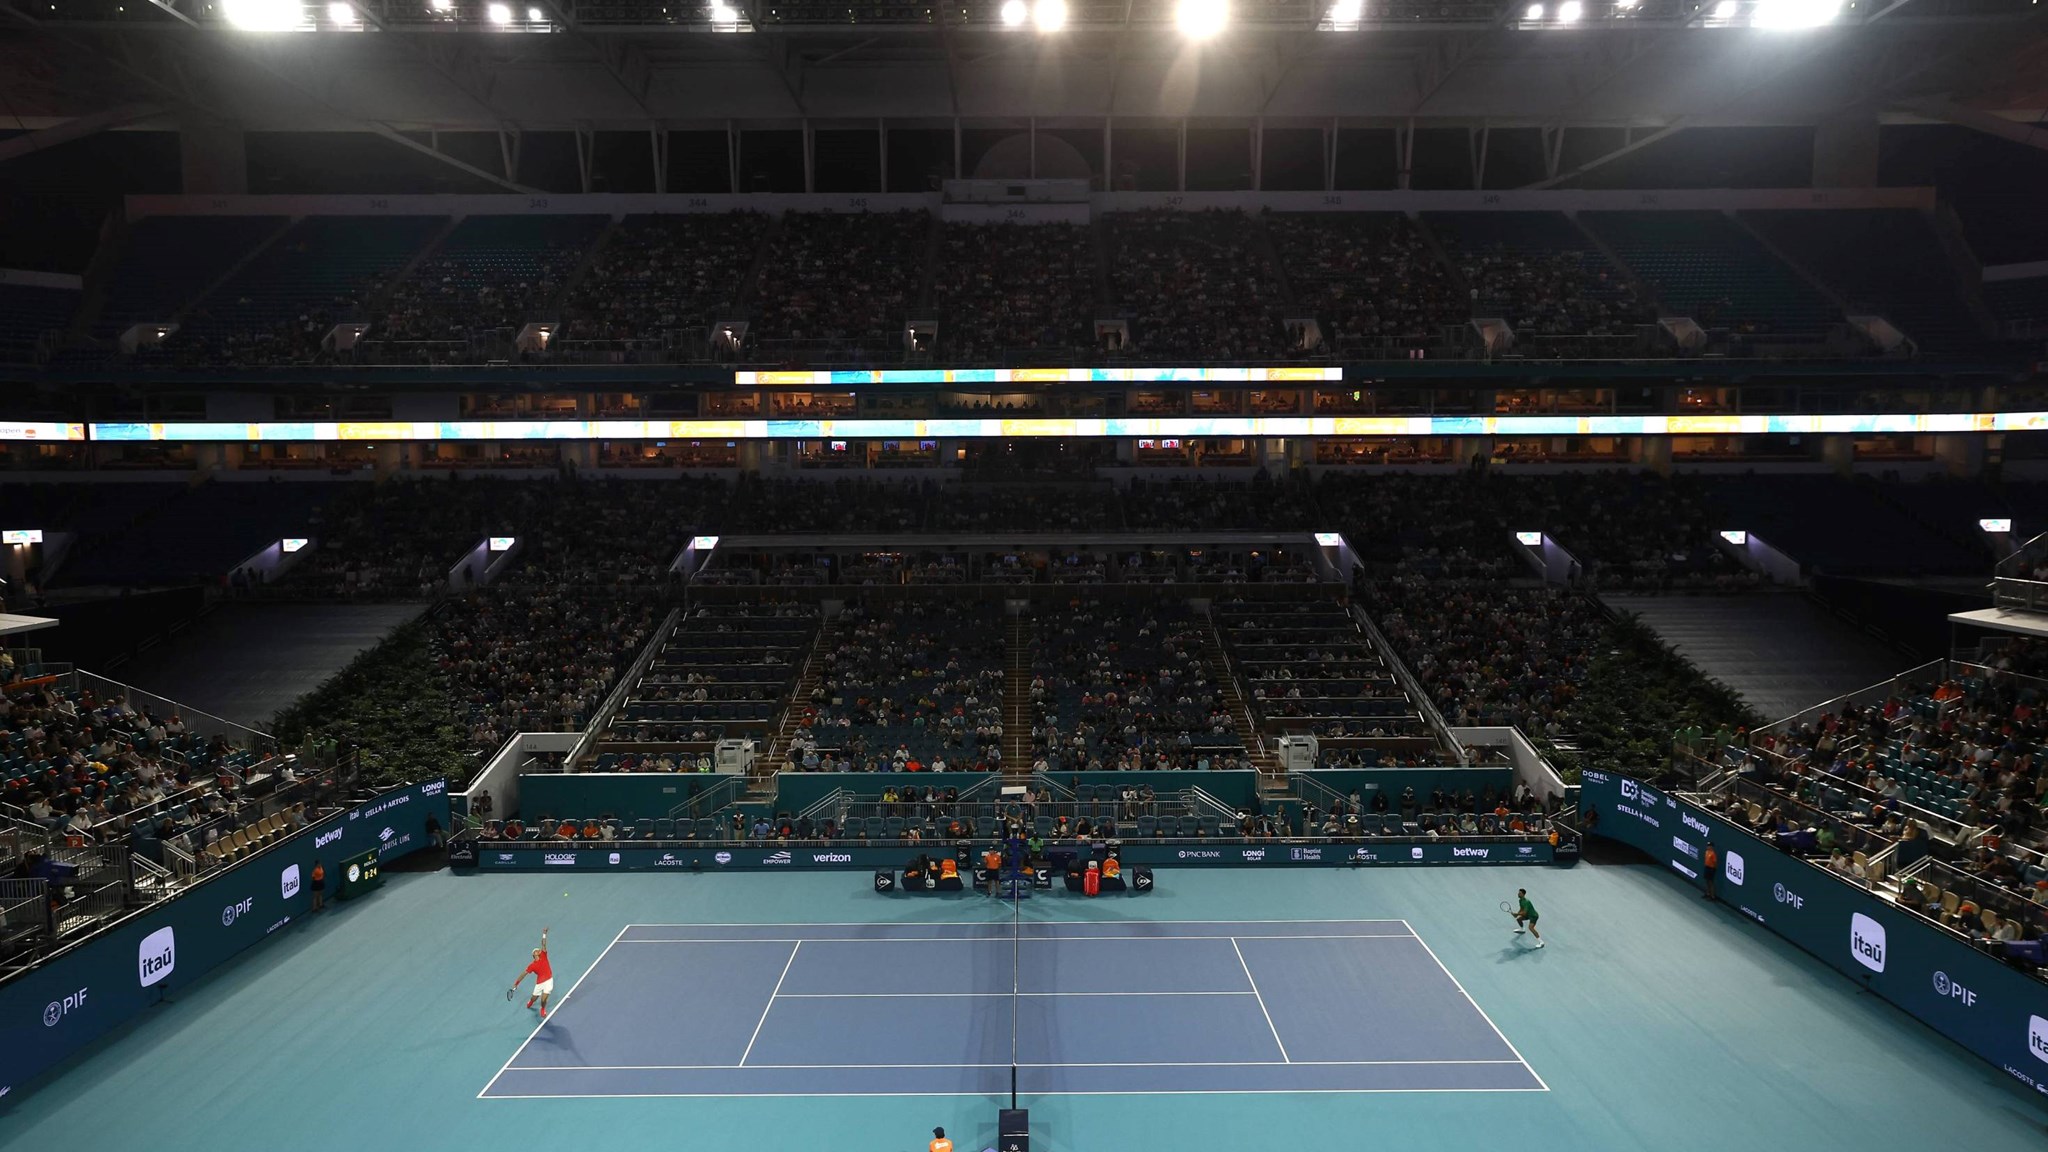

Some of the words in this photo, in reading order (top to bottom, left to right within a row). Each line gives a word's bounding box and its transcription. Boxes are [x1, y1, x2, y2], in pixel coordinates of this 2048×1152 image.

[529, 198, 548, 209] 343
[688, 198, 707, 208] 344
[848, 198, 867, 208] 345
[1165, 196, 1183, 206] 347
[1006, 209, 1026, 219] 346
[1582, 770, 1609, 781] DOBEL
[365, 806, 382, 818] STELLA
[387, 795, 409, 808] ARTOIS
[1617, 804, 1639, 817] STELLA
[1643, 814, 1660, 828] ARTOIS
[1682, 811, 1710, 837] betway
[71, 839, 78, 847] P
[315, 826, 343, 849] betway
[813, 852, 851, 862] verizon
[1453, 847, 1489, 858] betway
[1727, 862, 1743, 881] itaú
[283, 877, 299, 894] itaú
[235, 897, 253, 918] PIF
[1786, 890, 1804, 910] PIF
[1854, 932, 1882, 964] itaú
[142, 946, 172, 978] itaú
[63, 987, 88, 1015] PIF
[1951, 982, 1977, 1007] PIF
[2032, 1031, 2048, 1055] ita
[2004, 1063, 2035, 1086] LACOSTE
